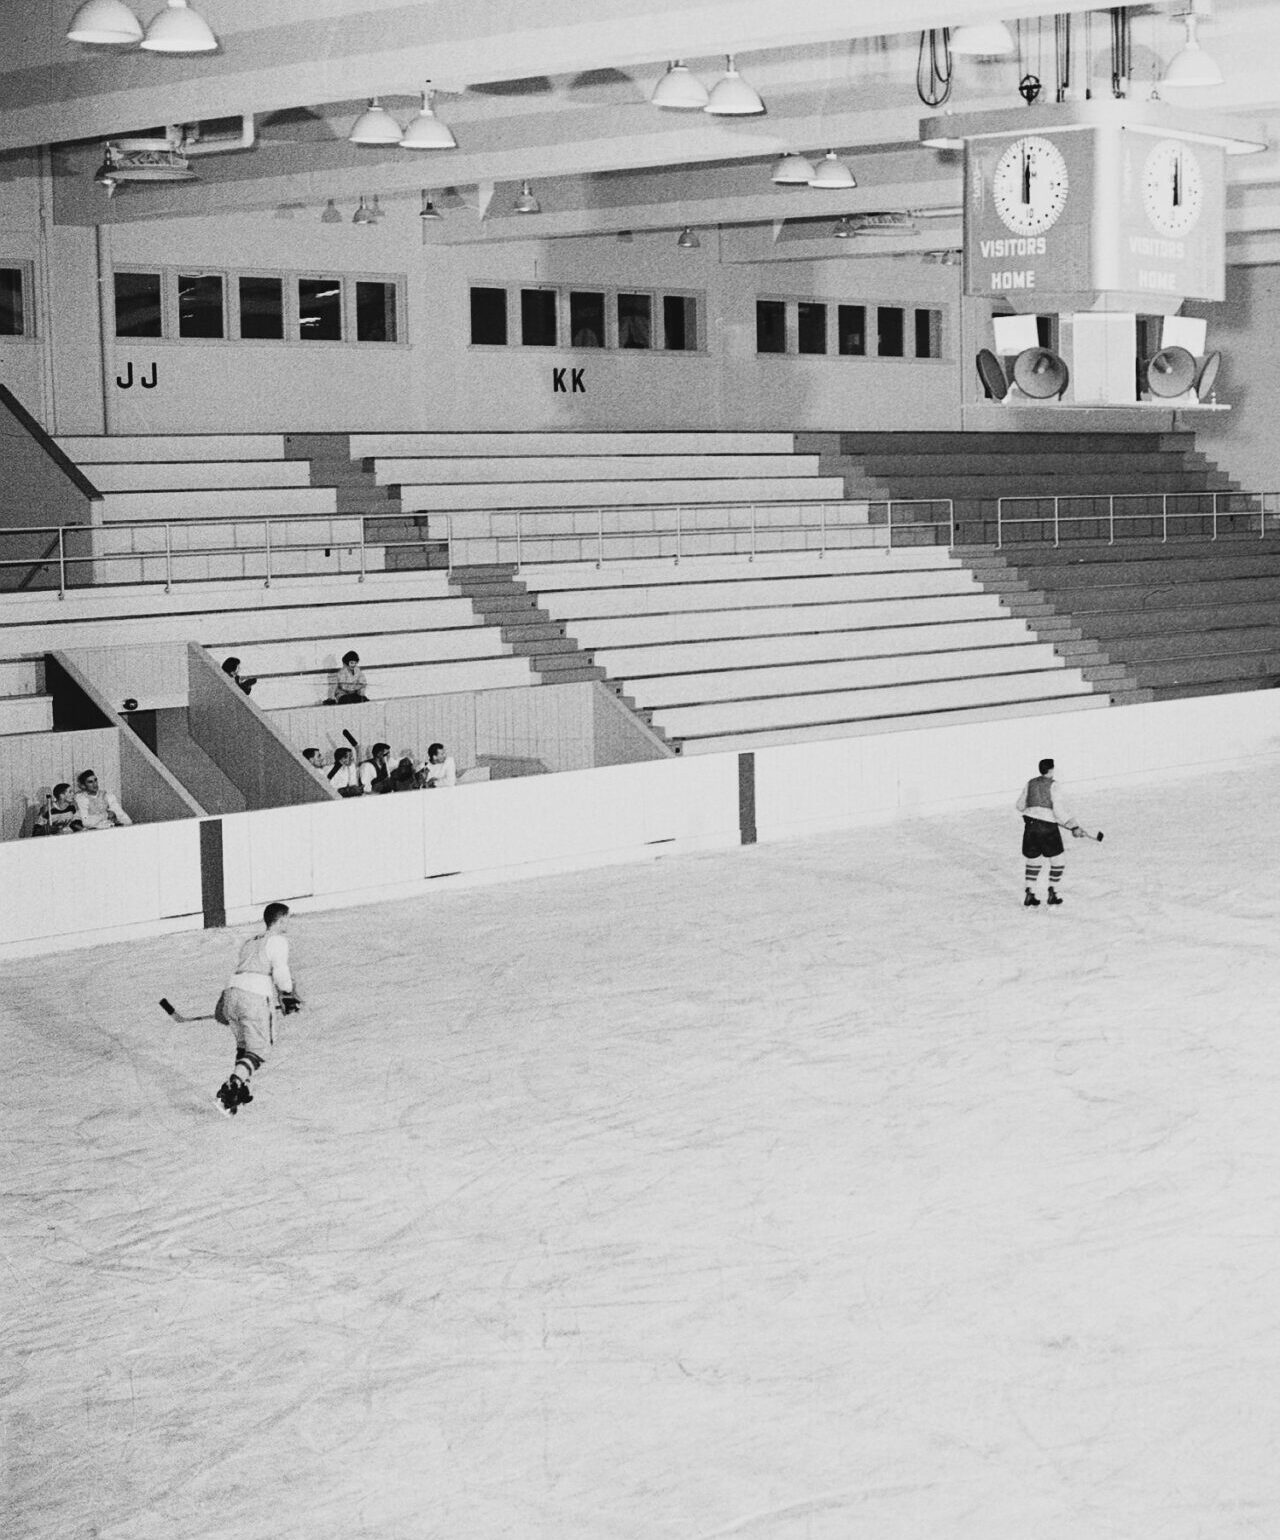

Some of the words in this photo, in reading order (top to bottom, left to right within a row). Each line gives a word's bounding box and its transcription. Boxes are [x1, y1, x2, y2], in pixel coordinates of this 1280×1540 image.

[980, 237, 1047, 258] VISITORS
[1129, 236, 1185, 259] VISITORS
[991, 270, 1035, 289] HOME
[1138, 270, 1176, 290] HOME
[116, 362, 158, 389] JJ
[553, 368, 586, 393] KK
